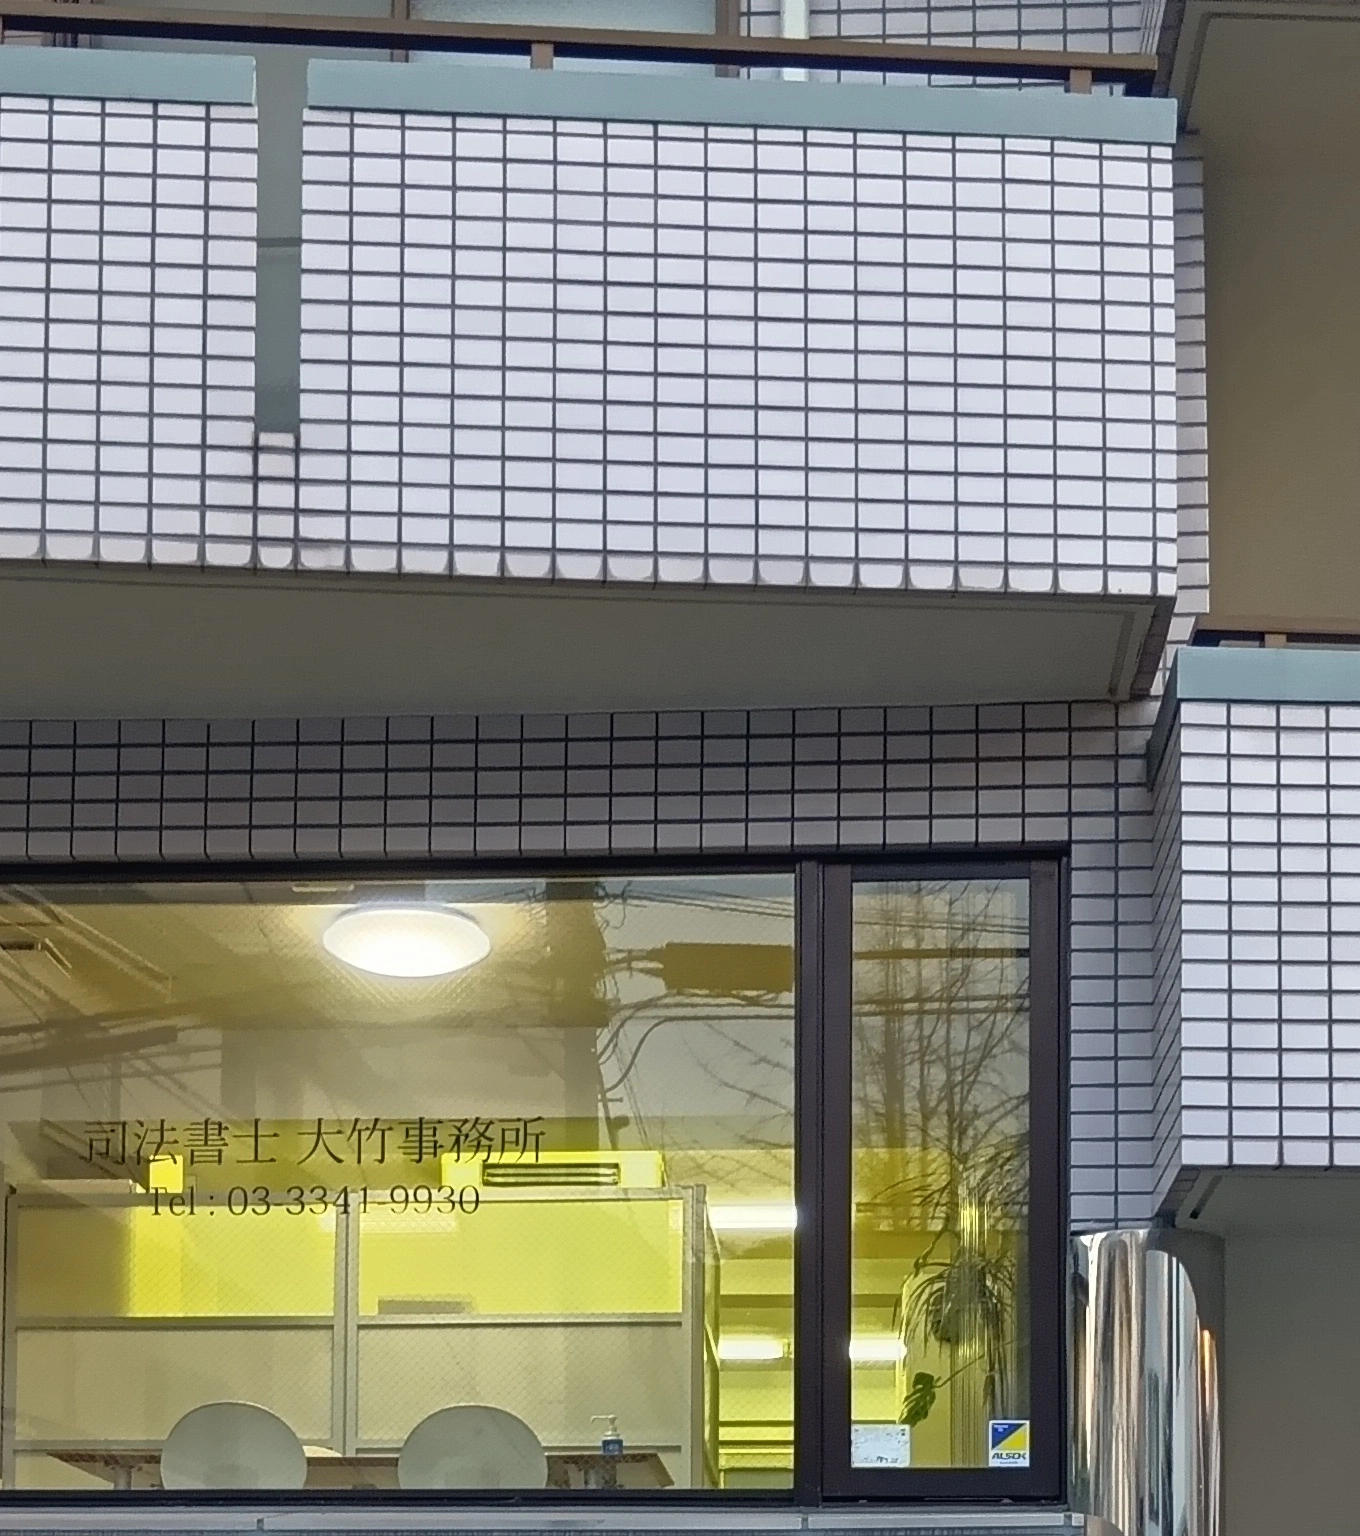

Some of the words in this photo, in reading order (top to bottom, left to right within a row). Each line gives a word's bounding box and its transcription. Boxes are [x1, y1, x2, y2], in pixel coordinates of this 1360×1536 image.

[79, 1118, 280, 1165] 司法書士
[296, 1116, 547, 1165] 大竹事務所
[227, 1185, 481, 1217] 03-3341-9930
[992, 1452, 1026, 1460] ALSOK
